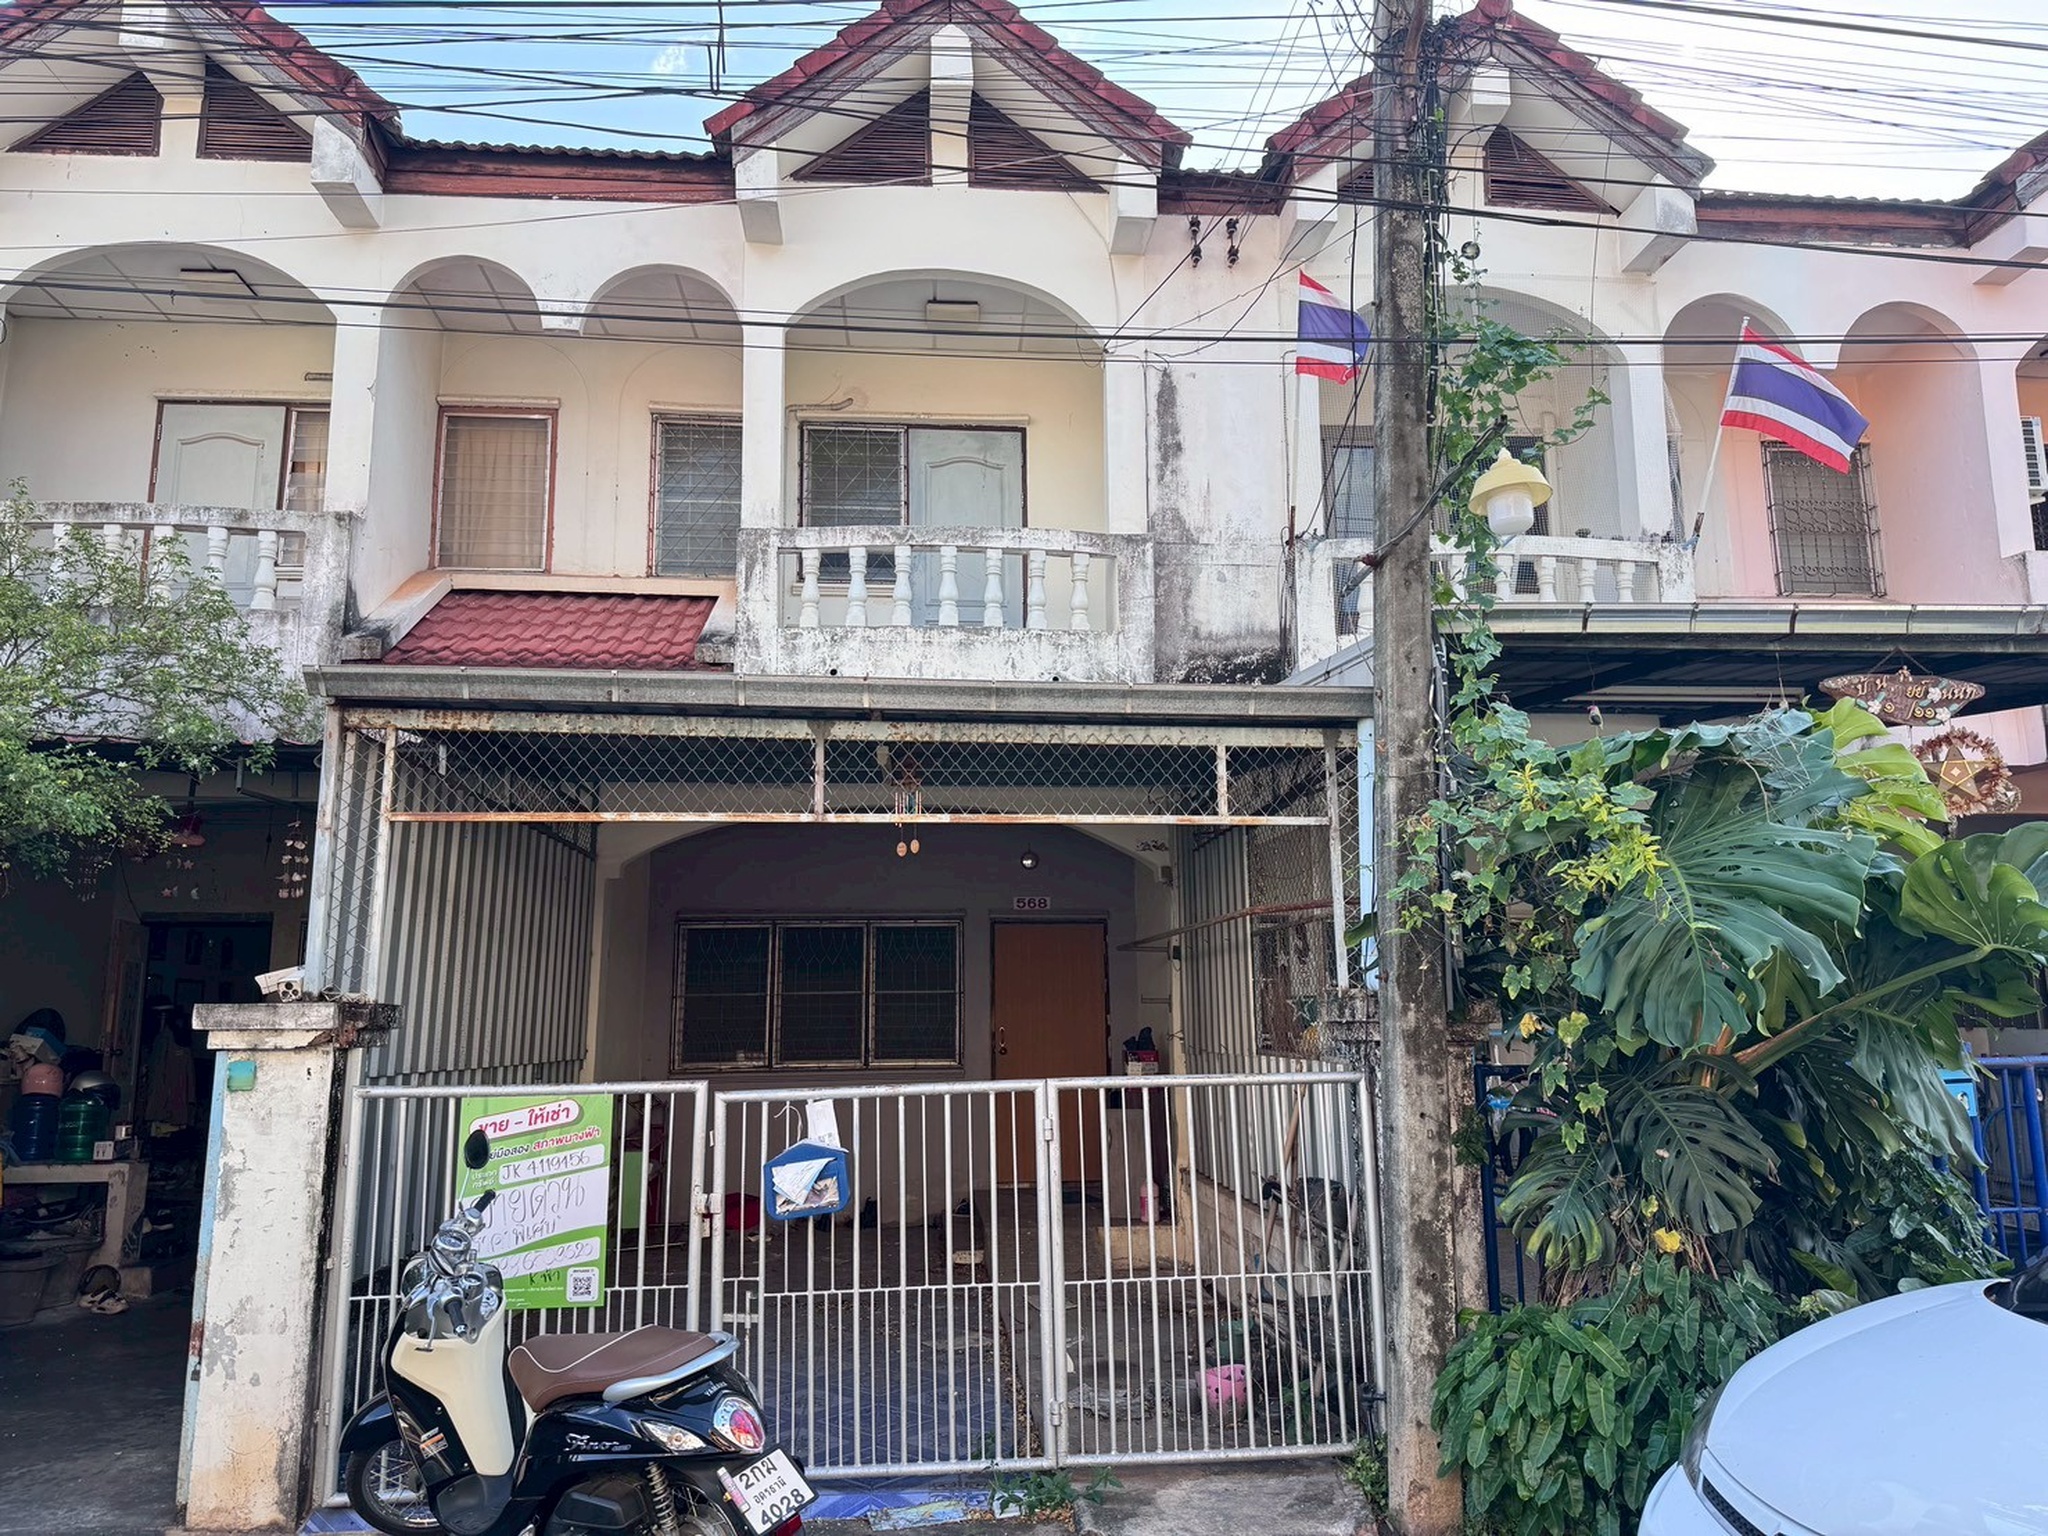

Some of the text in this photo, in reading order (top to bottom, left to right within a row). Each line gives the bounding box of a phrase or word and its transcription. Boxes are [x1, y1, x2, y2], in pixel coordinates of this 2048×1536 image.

[1016, 897, 1048, 909] 568
[478, 1118, 510, 1135] ขาย
[528, 1104, 571, 1127] ให้เช่า
[488, 1126, 601, 1160] ย์มือสอง สภาพนางฟ้า
[502, 1163, 521, 1180] JK
[563, 1433, 620, 1451] Fino
[753, 1476, 787, 1505] อุดรธานี
[761, 1488, 805, 1526] 4028
